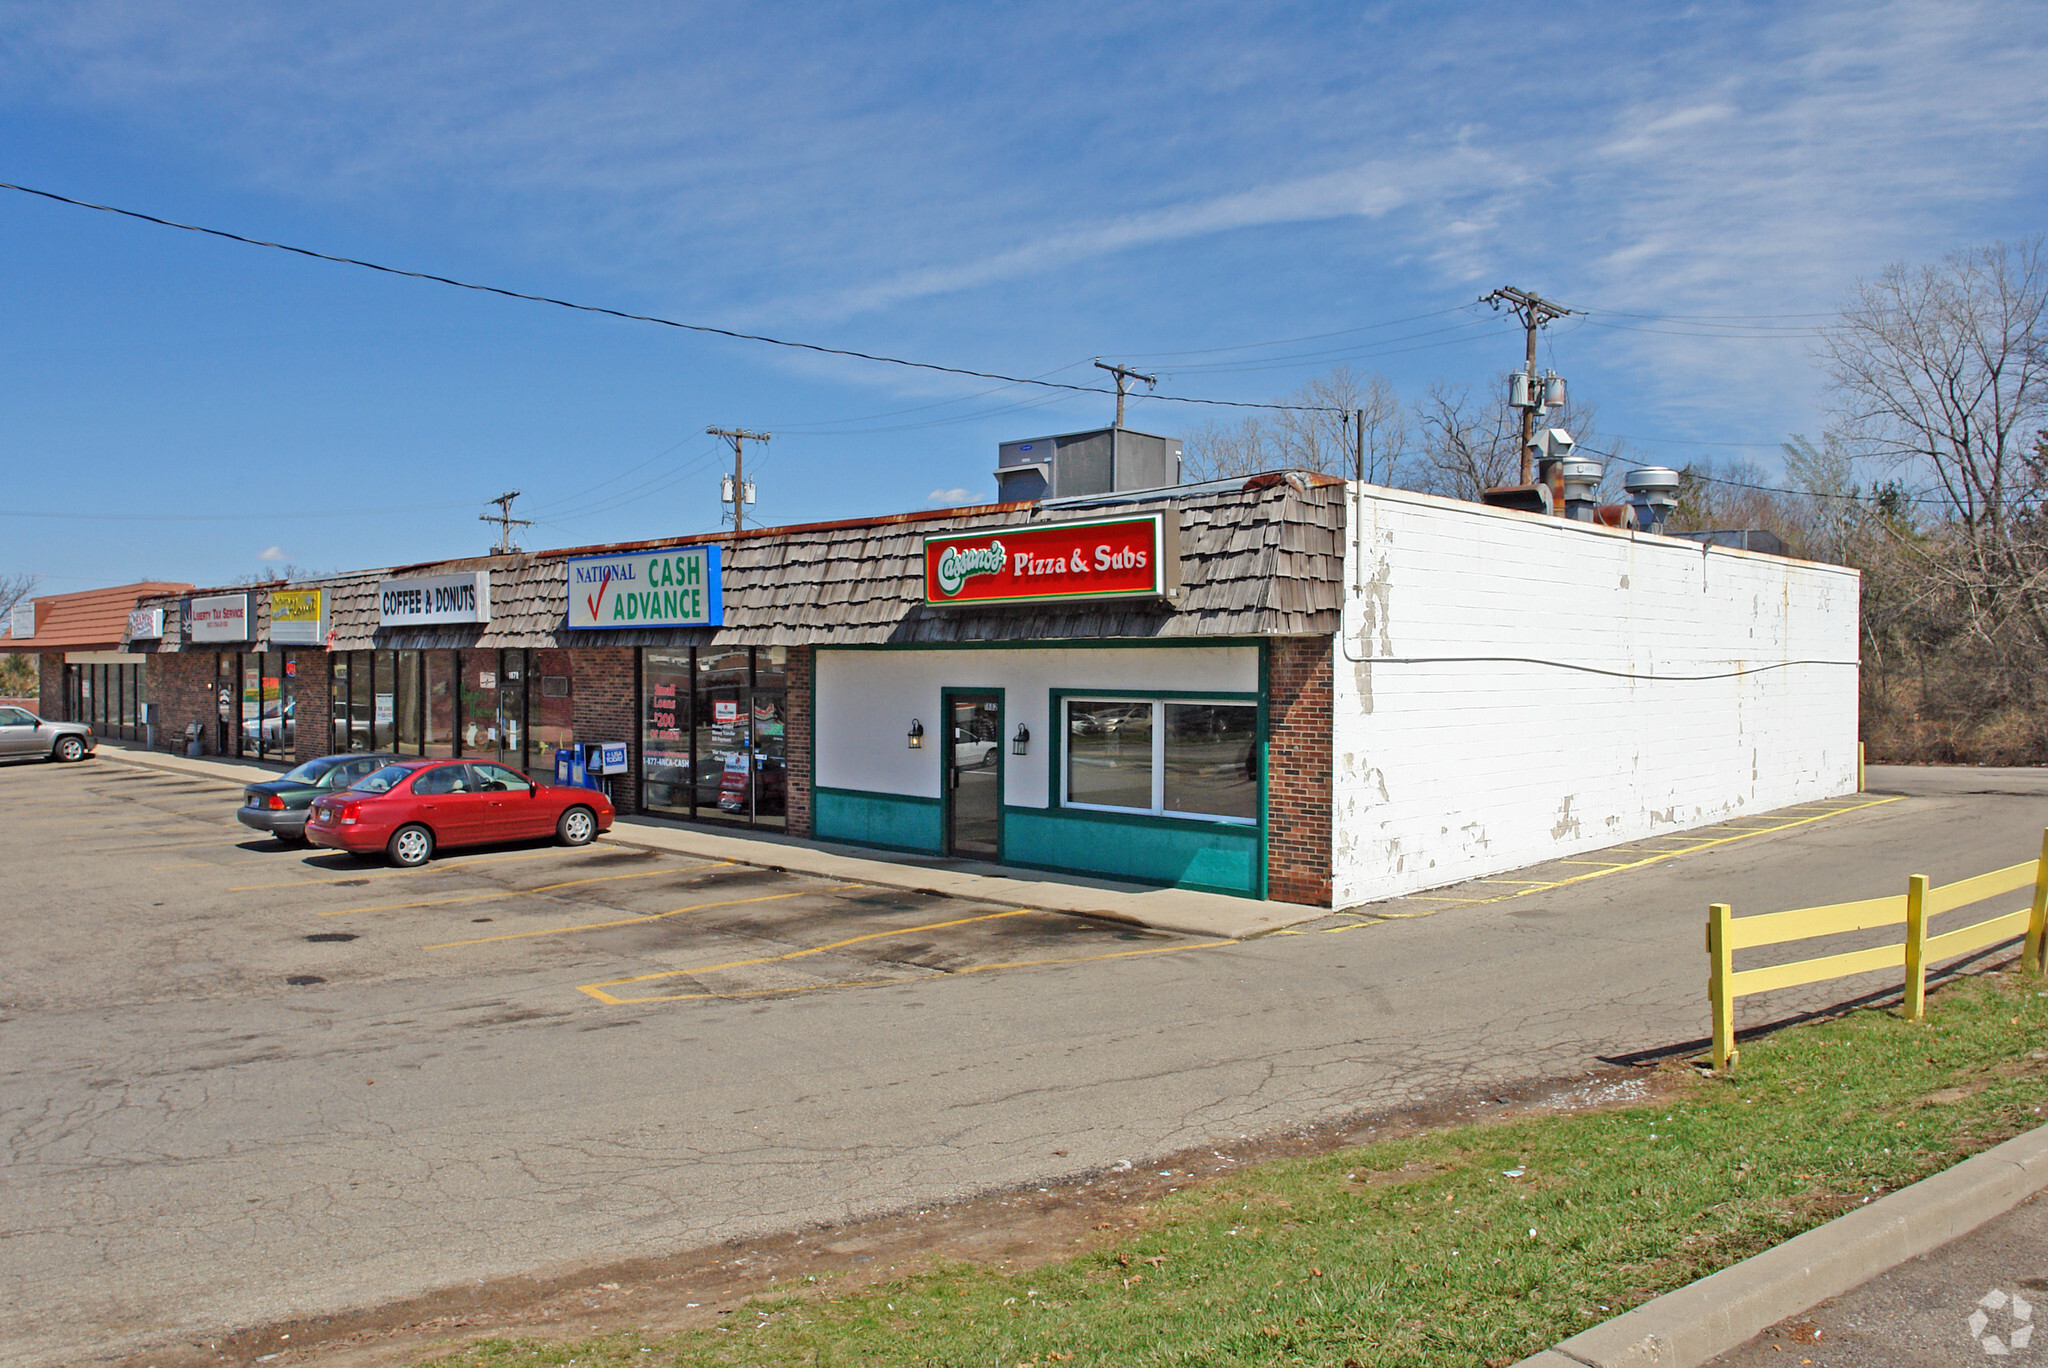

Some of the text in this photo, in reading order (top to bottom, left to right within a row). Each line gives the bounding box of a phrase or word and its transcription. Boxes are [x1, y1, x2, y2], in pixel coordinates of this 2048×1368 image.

[576, 563, 636, 583] NATIONAL
[648, 556, 700, 588] CASH
[937, 540, 1147, 596] Cassano's Pizza & Subs
[383, 584, 475, 616] COFFEE & DONUTS
[613, 589, 700, 620] ADVANCE
[654, 683, 676, 696] Small
[653, 696, 676, 709] Loans
[654, 712, 675, 727] $200
[650, 730, 680, 740] or more
[606, 755, 623, 763] TODAY
